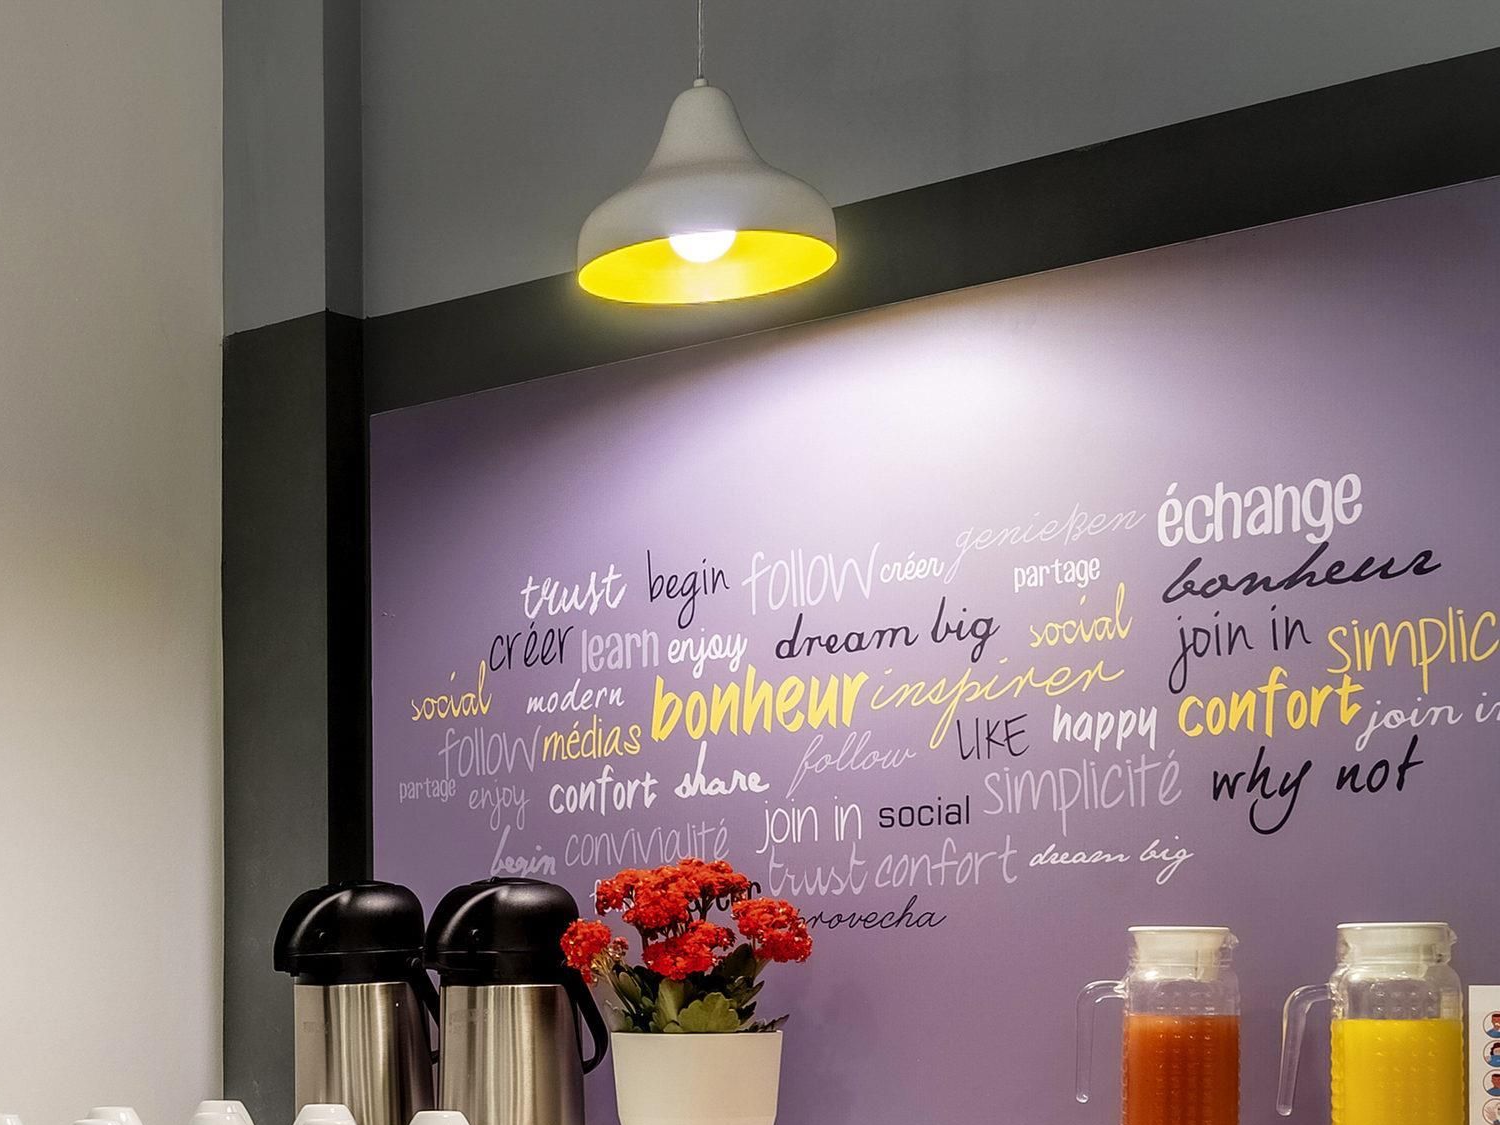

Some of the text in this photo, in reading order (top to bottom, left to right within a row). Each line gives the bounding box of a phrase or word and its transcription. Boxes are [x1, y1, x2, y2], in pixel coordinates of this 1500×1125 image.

[1157, 473, 1363, 547] échange
[880, 551, 944, 583] créer
[944, 502, 1147, 584] genießen
[520, 564, 627, 619] trust
[647, 549, 730, 629] begin
[741, 541, 880, 615] follow
[1014, 558, 1100, 593] partage
[1161, 541, 1442, 604] bonheur
[775, 596, 1000, 663] dream big
[1029, 582, 1132, 648] social
[489, 622, 574, 672] créer
[581, 628, 659, 673] learn
[667, 628, 747, 679] enjoy
[1168, 604, 1312, 694] join in
[410, 660, 493, 721] social
[526, 678, 625, 714] modern
[650, 664, 870, 742] bonheur
[871, 656, 1125, 749] inspirer
[1177, 666, 1364, 738] confort
[438, 725, 542, 779] follow
[542, 715, 642, 762] médias
[1052, 703, 1157, 752] happy
[1355, 697, 1463, 752] join
[400, 777, 456, 803] partage
[549, 764, 659, 816] confort
[674, 740, 769, 799] share
[786, 731, 917, 799] follow
[983, 747, 1182, 836] simplicité
[1212, 735, 1423, 834] why not
[469, 779, 530, 831] enjoy
[756, 795, 862, 854] join in
[879, 795, 970, 828] social
[490, 824, 556, 877] begin
[565, 818, 729, 867] convivialité
[769, 840, 868, 897] trust
[874, 834, 1017, 888] confort
[1028, 835, 1194, 884] dream big
